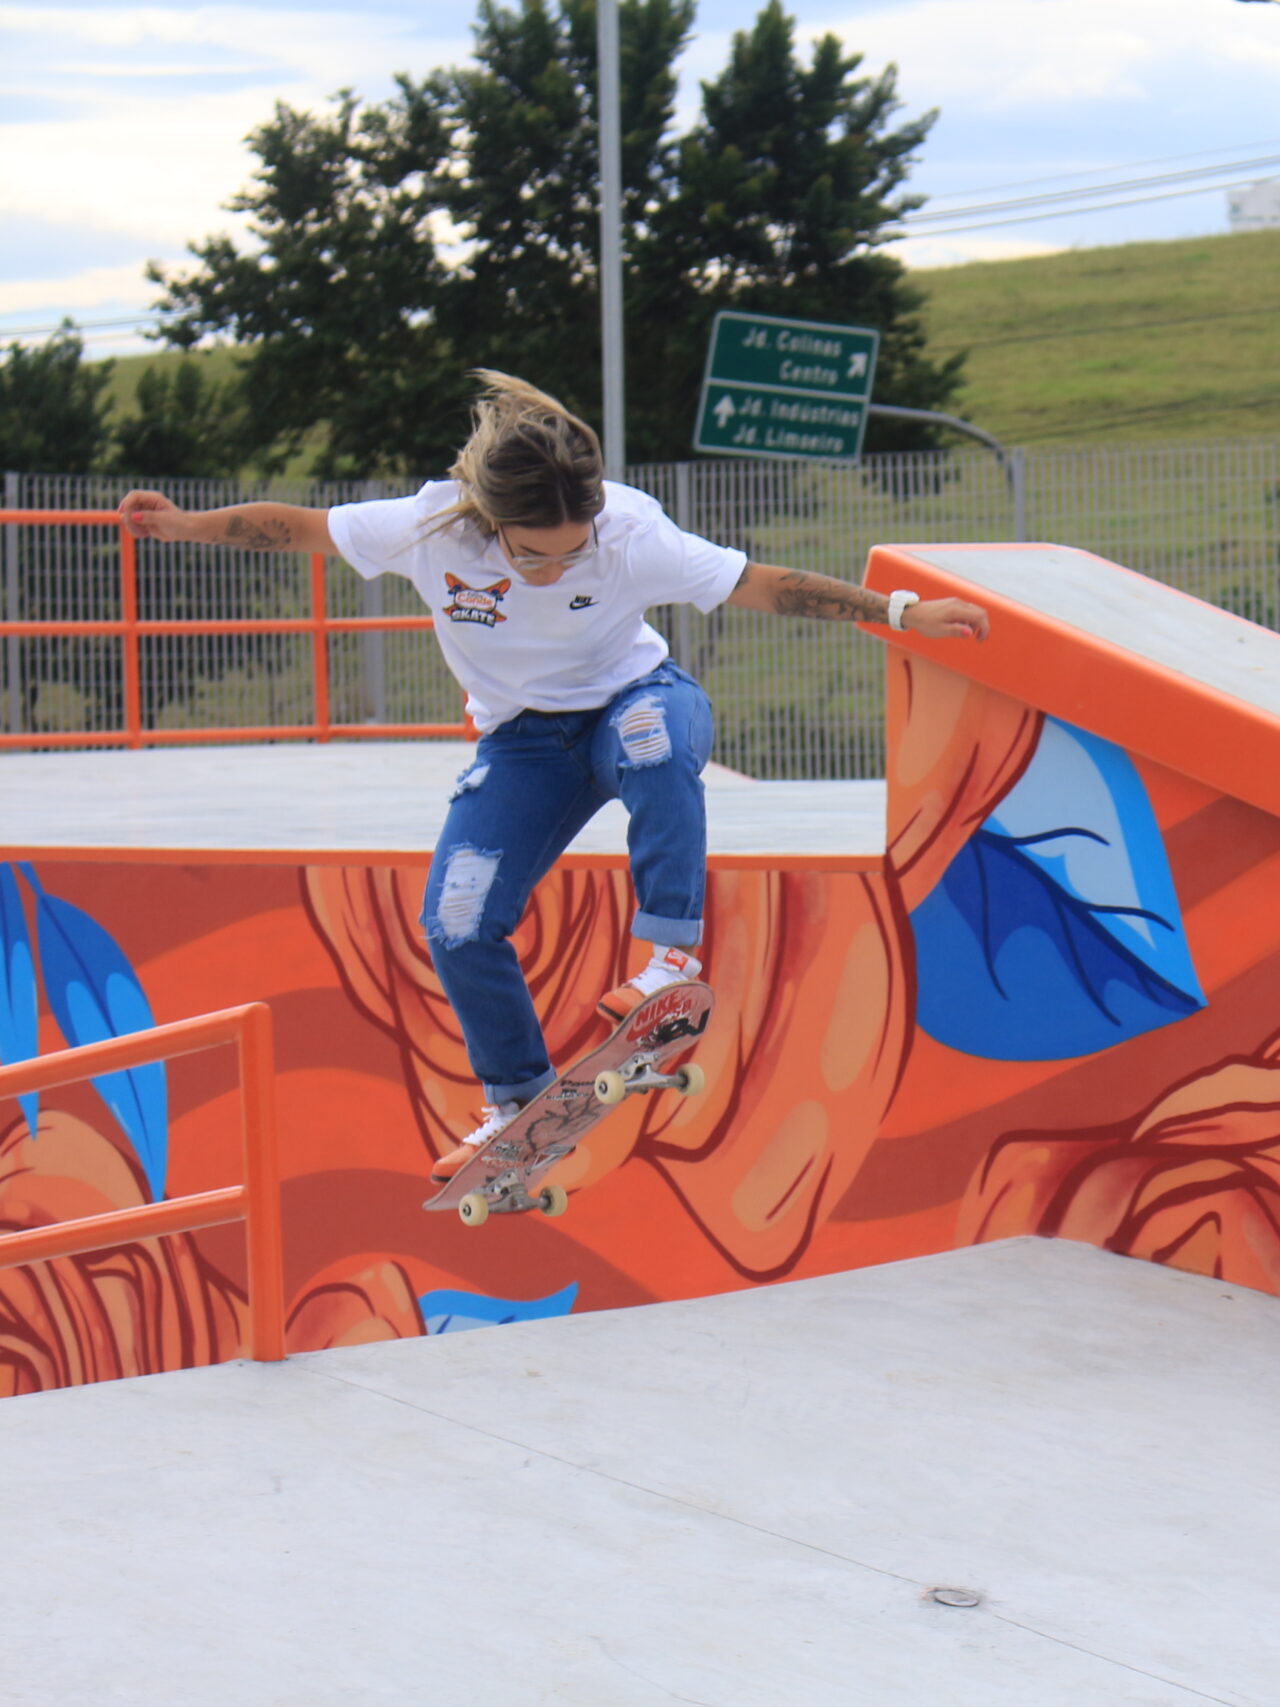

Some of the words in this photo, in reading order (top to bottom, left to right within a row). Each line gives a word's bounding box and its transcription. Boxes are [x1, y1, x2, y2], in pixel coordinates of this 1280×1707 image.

[776, 330, 842, 357] Colinas
[779, 359, 838, 385] Centro
[765, 427, 844, 453] Limoeiro
[452, 608, 495, 627] SKATE
[636, 990, 680, 1026] NIKE
